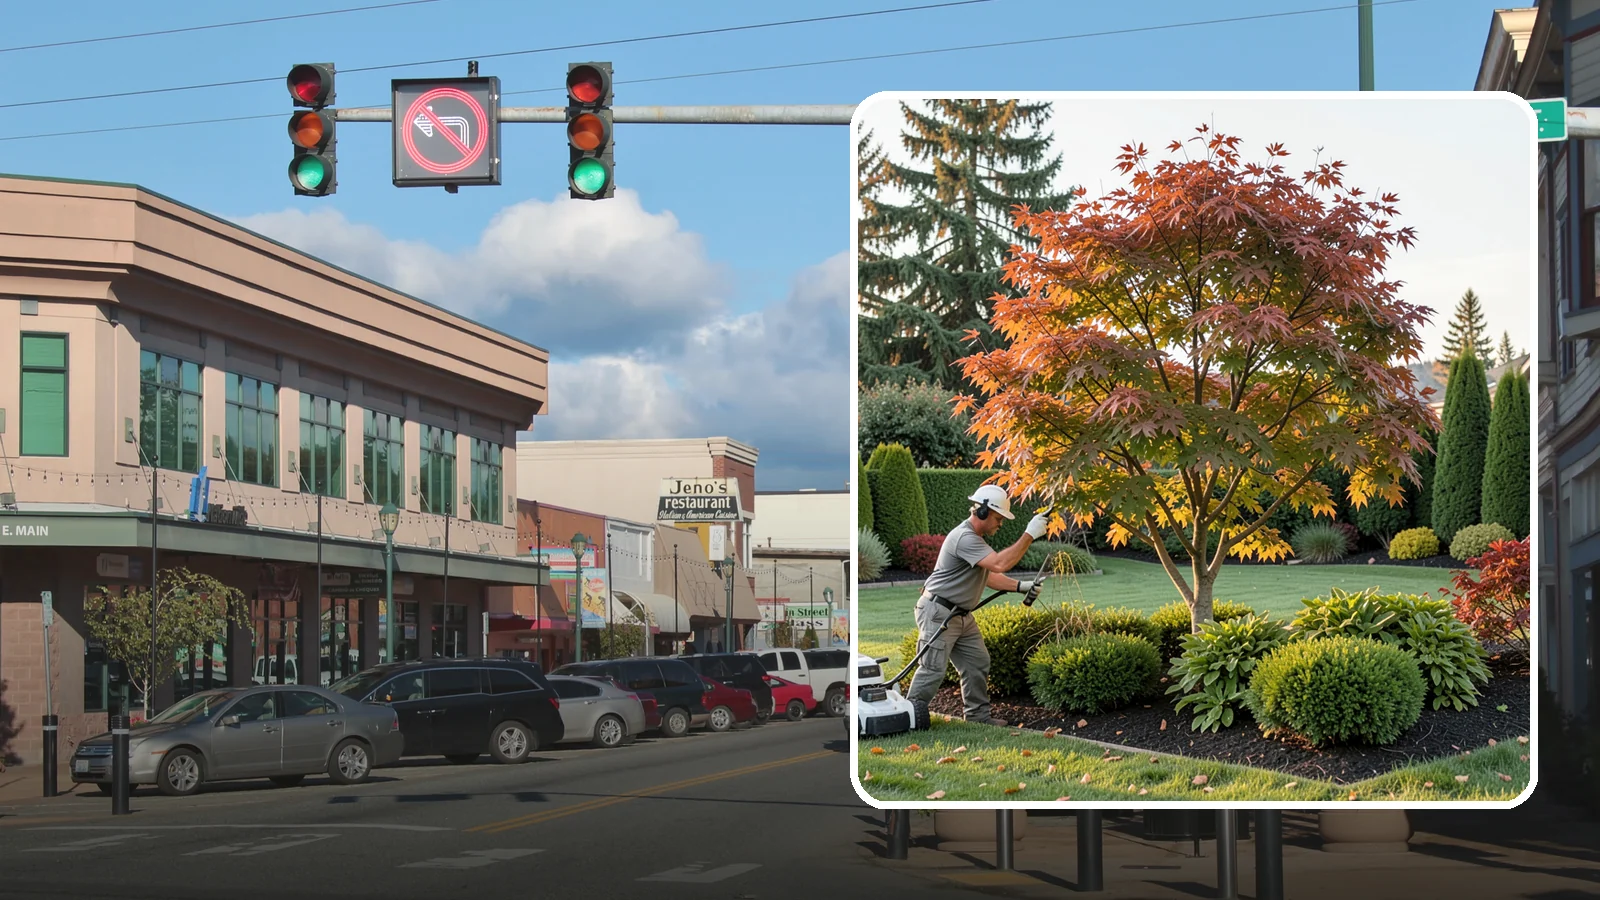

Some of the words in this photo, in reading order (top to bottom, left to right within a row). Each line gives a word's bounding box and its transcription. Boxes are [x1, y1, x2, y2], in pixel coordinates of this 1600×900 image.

[669, 480, 727, 494] Jeno's
[665, 496, 731, 509] restaurant
[658, 510, 682, 520] Italian
[686, 510, 714, 519] American
[715, 510, 737, 519] Cuisine
[2, 525, 13, 536] E.
[15, 525, 49, 536] MAIN
[785, 606, 795, 616] in
[797, 607, 828, 616] Street
[790, 619, 823, 627] lass
